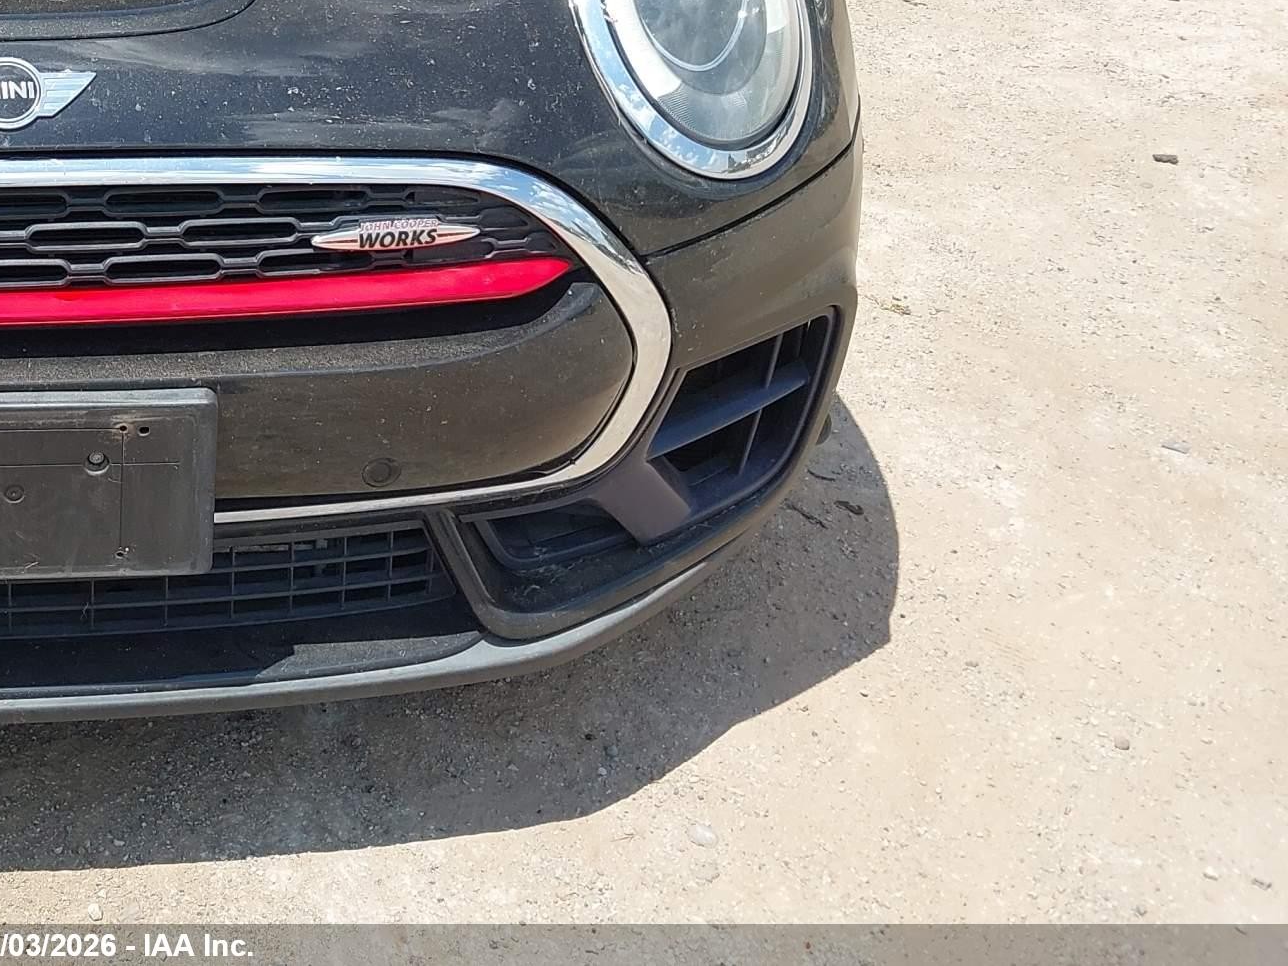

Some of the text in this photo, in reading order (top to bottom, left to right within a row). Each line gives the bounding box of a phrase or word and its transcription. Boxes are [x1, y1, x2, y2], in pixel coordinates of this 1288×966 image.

[360, 218, 438, 233] JOHN COOPER
[359, 228, 438, 249] WORKS
